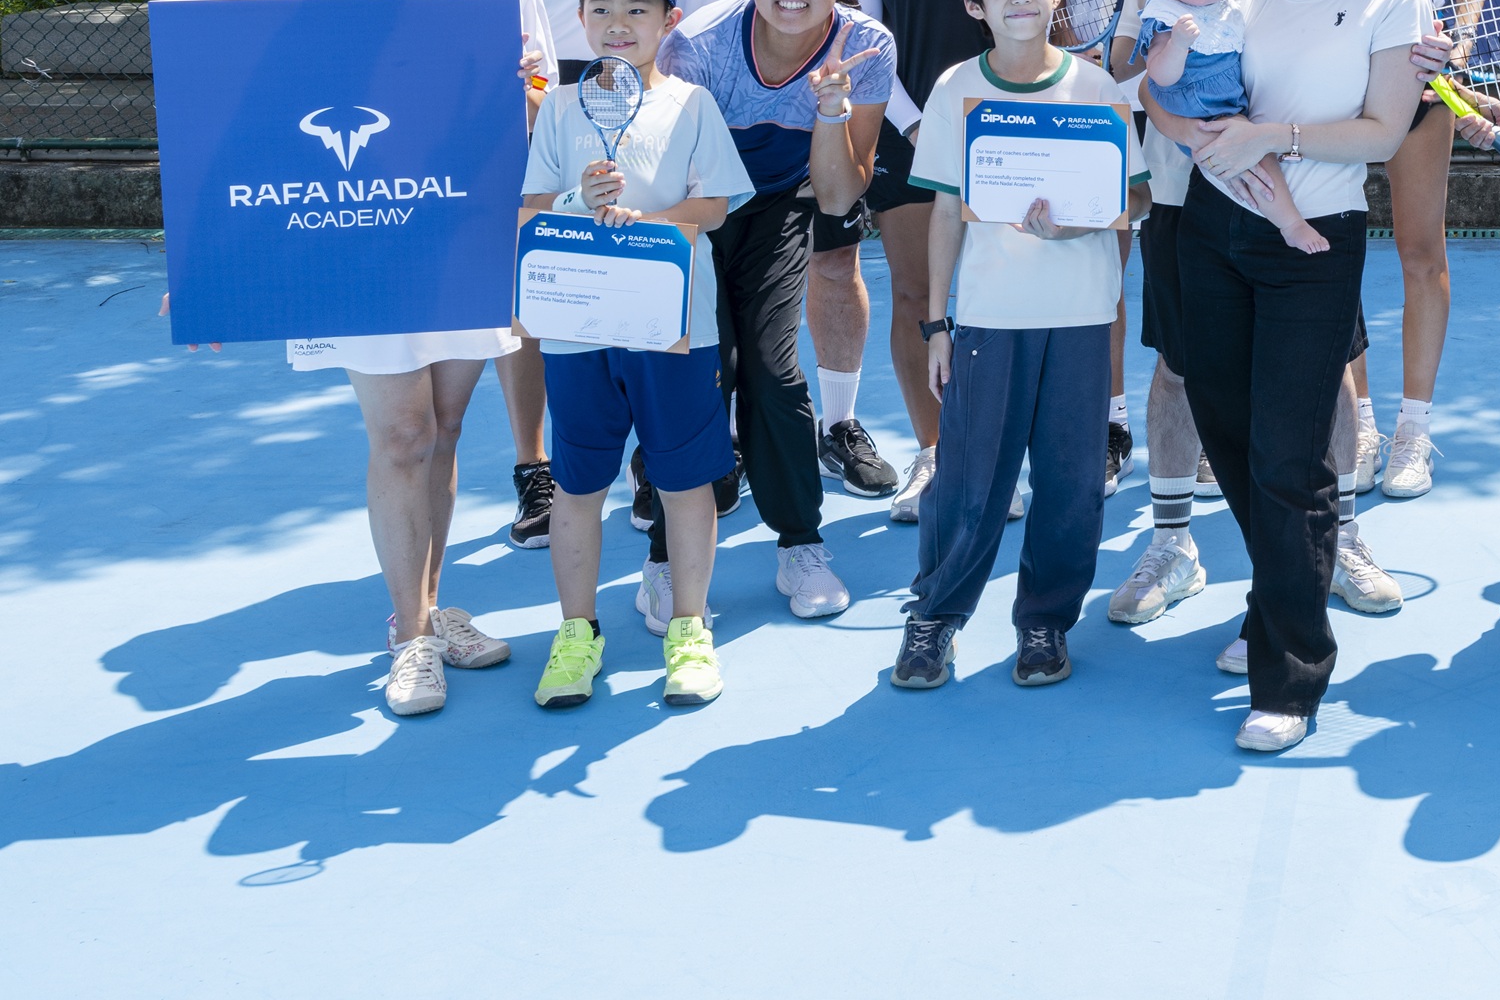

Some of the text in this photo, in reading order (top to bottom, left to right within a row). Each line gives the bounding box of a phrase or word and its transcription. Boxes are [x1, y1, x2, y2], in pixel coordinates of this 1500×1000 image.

[981, 114, 1036, 125] DIPLOMA
[229, 176, 468, 208] RAFA NADAL
[287, 207, 414, 230] ACADEMY
[535, 227, 594, 241] DIPLOMA
[536, 289, 565, 298] successfully
